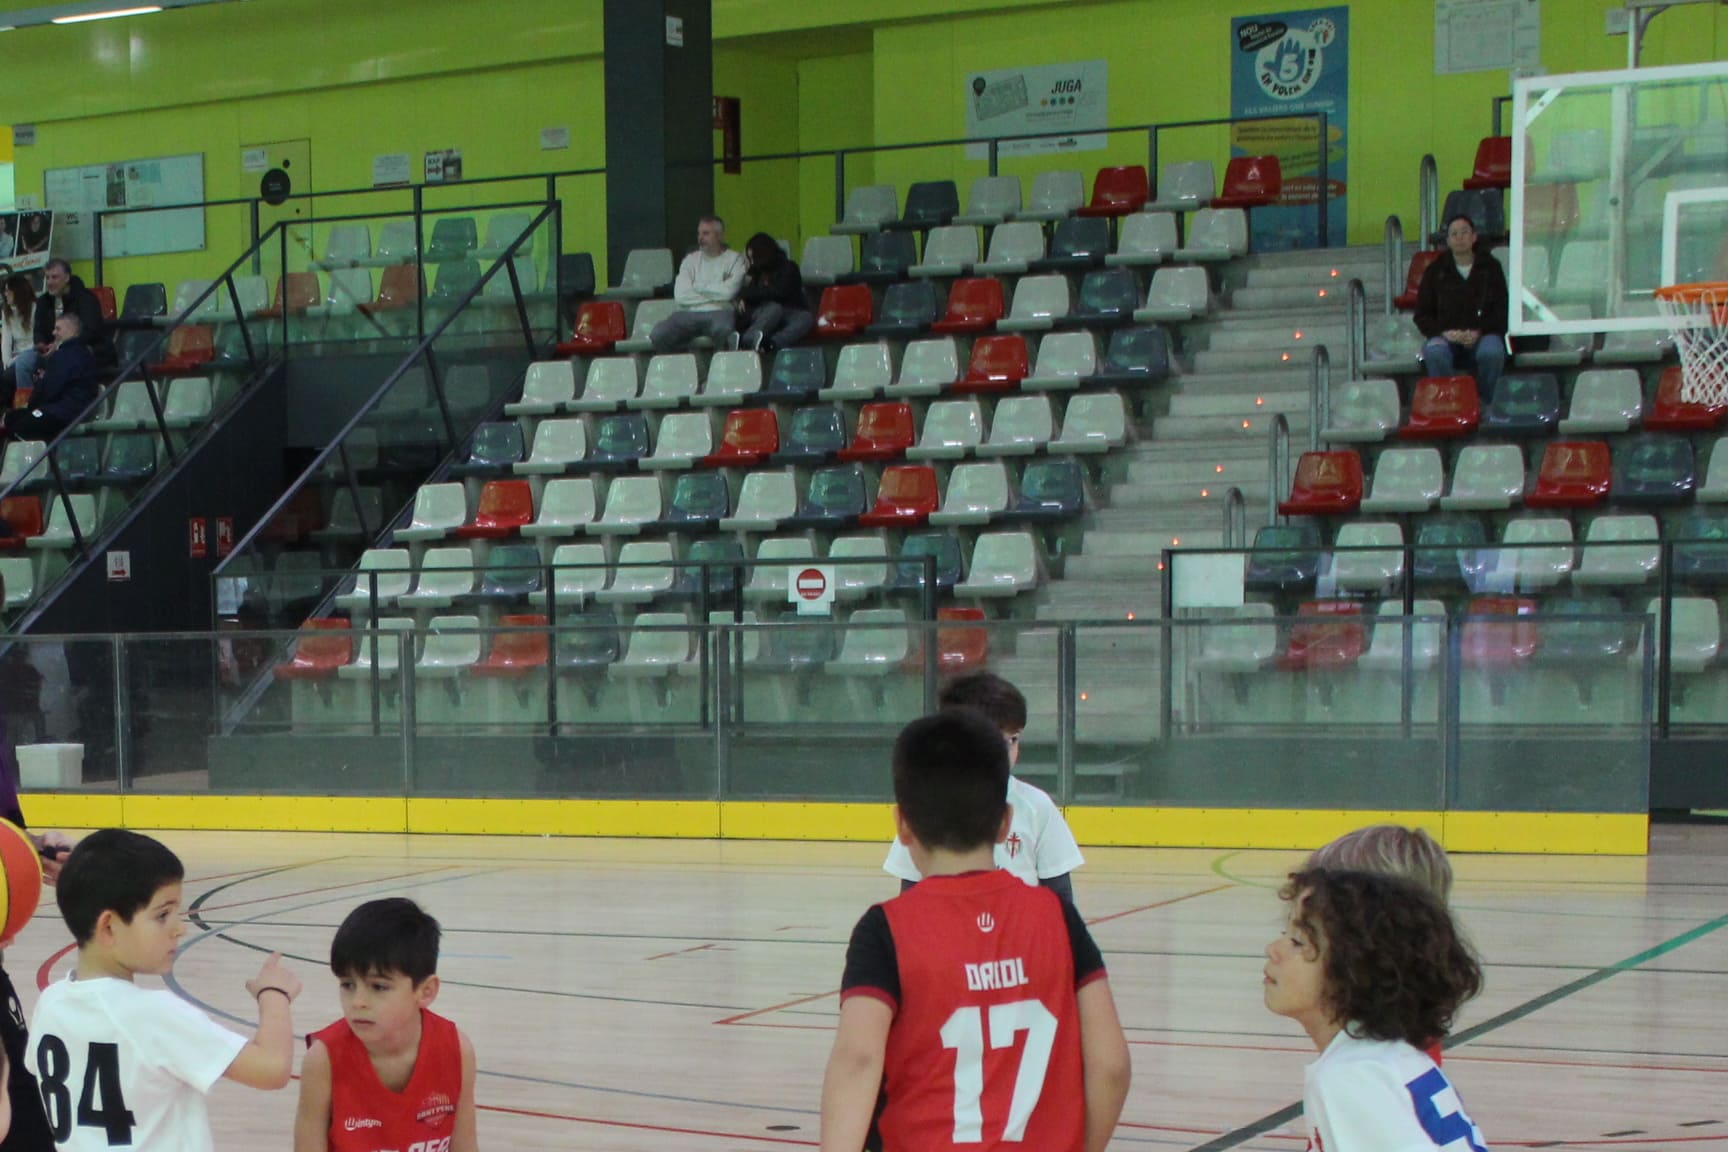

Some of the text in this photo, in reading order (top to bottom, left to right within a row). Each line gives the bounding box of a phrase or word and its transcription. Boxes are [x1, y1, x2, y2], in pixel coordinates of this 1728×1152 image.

[1051, 79, 1082, 94] JUGA
[1279, 53, 1299, 81] 5
[37, 1034, 137, 1146] 84
[939, 998, 1059, 1144] 17
